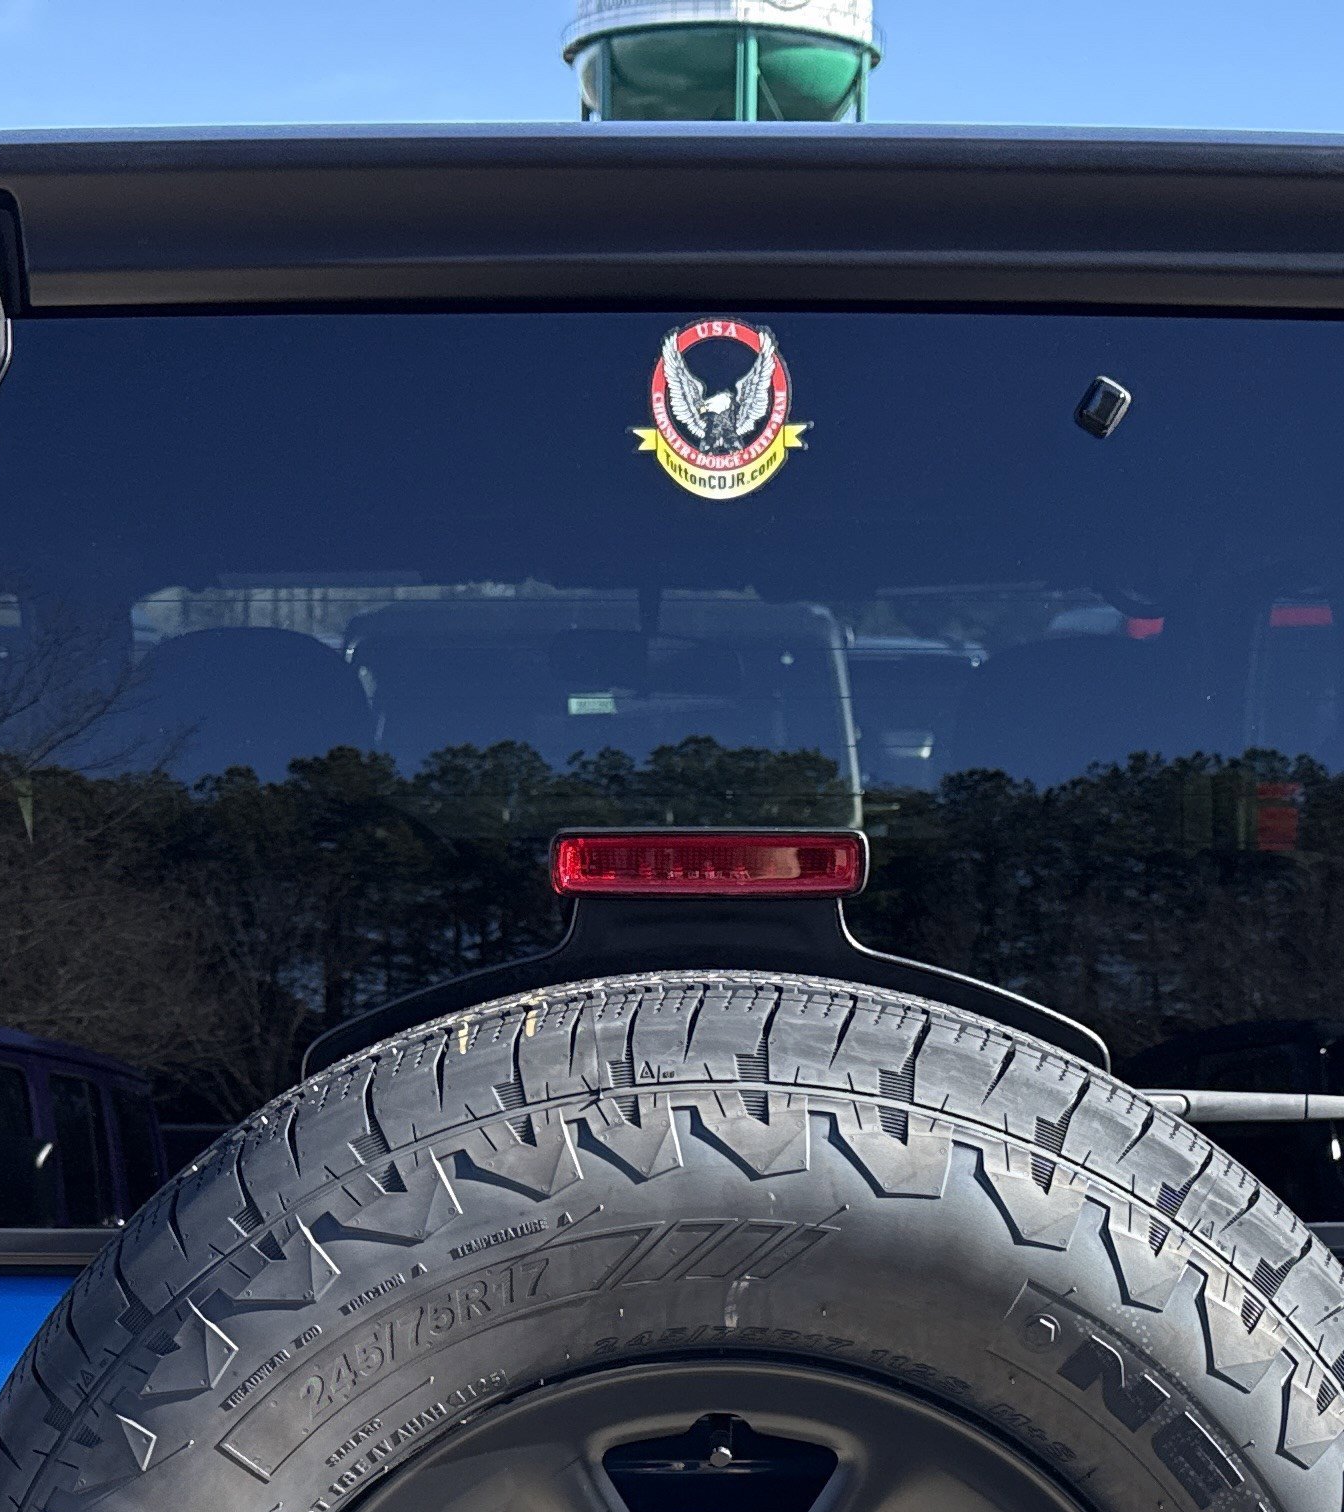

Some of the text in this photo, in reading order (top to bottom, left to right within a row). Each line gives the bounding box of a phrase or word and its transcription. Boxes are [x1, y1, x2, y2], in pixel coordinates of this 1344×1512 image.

[696, 322, 737, 338] USA
[664, 449, 777, 490] TuttonCDJR.com
[220, 1348, 291, 1411] TREADWEAR
[338, 1273, 406, 1316] TRACTION
[412, 1262, 428, 1279] A
[450, 1217, 550, 1260] TEMPERATURE
[557, 1211, 574, 1228] A
[302, 1257, 551, 1412] 245/75R17
